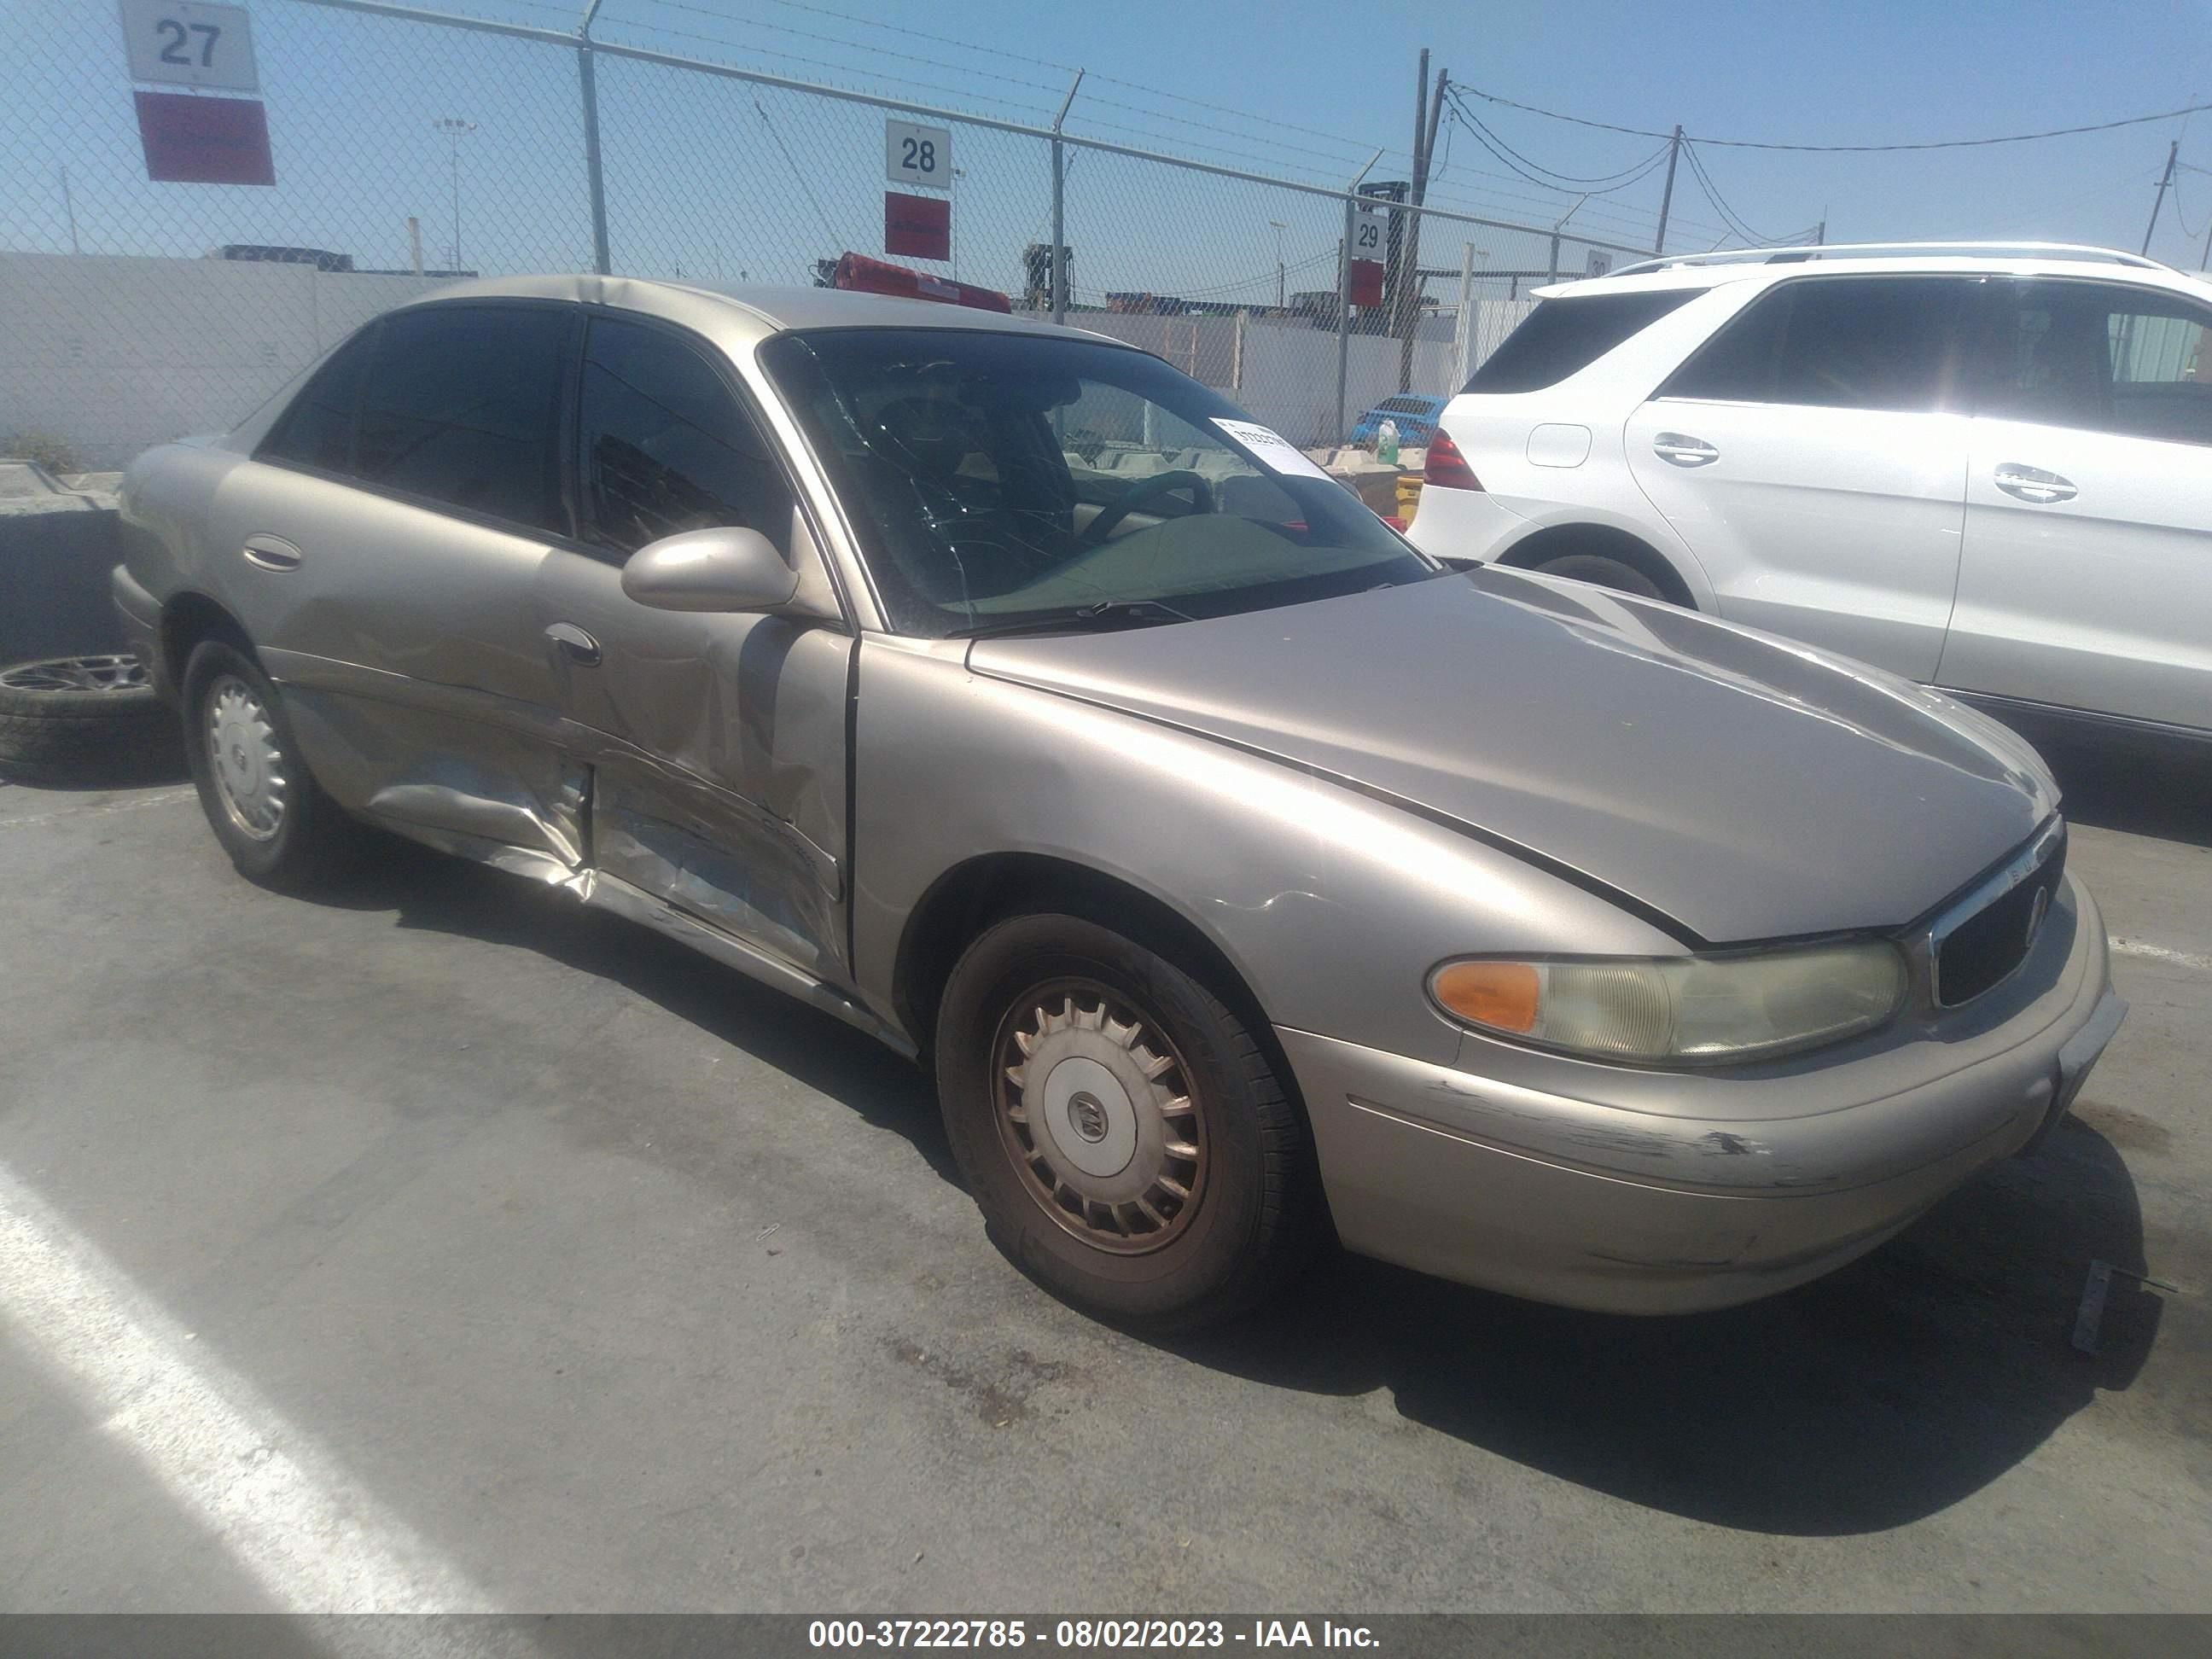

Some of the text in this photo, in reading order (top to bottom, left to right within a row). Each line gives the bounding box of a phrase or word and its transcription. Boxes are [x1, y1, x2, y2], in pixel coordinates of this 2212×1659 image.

[156, 18, 222, 67] 27
[902, 137, 936, 173] 28
[1359, 223, 1378, 248] 29
[1592, 259, 1605, 278] 30
